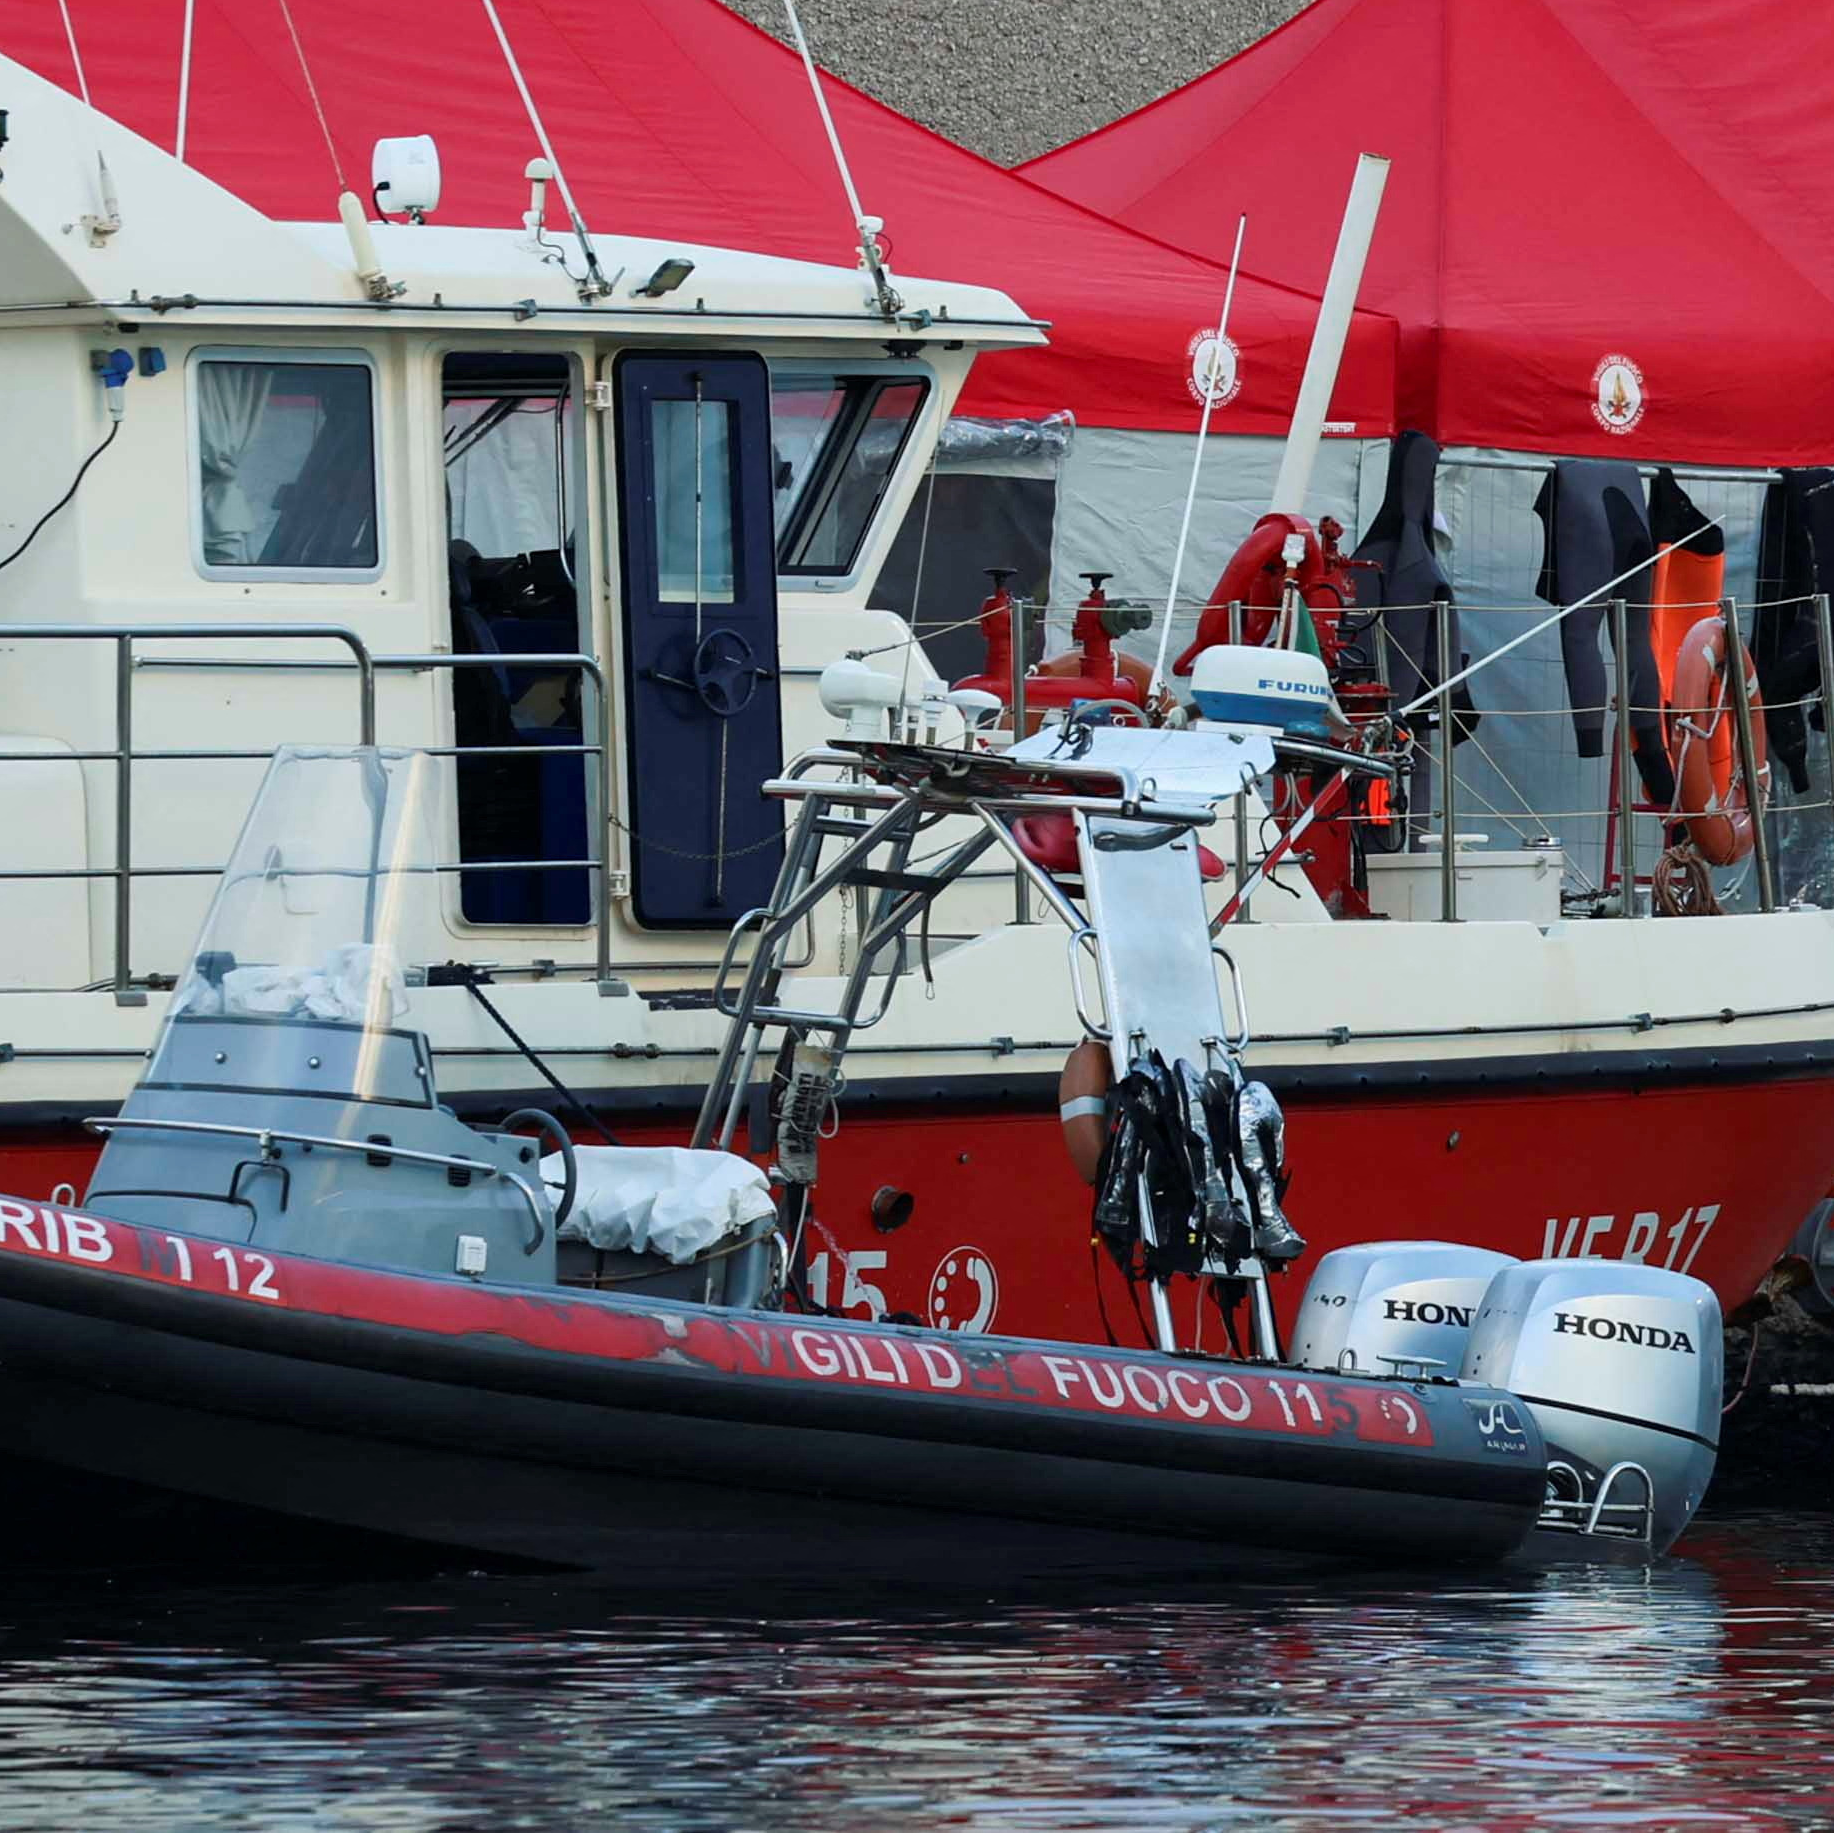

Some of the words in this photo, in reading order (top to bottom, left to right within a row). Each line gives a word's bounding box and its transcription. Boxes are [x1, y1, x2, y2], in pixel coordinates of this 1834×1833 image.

[1542, 1214, 1616, 1261] VF
[1621, 1203, 1722, 1275] R17
[1382, 1299, 1476, 1328] HON
[1552, 1312, 1696, 1354] HONDA
[1039, 1354, 1252, 1422] FUOCO
